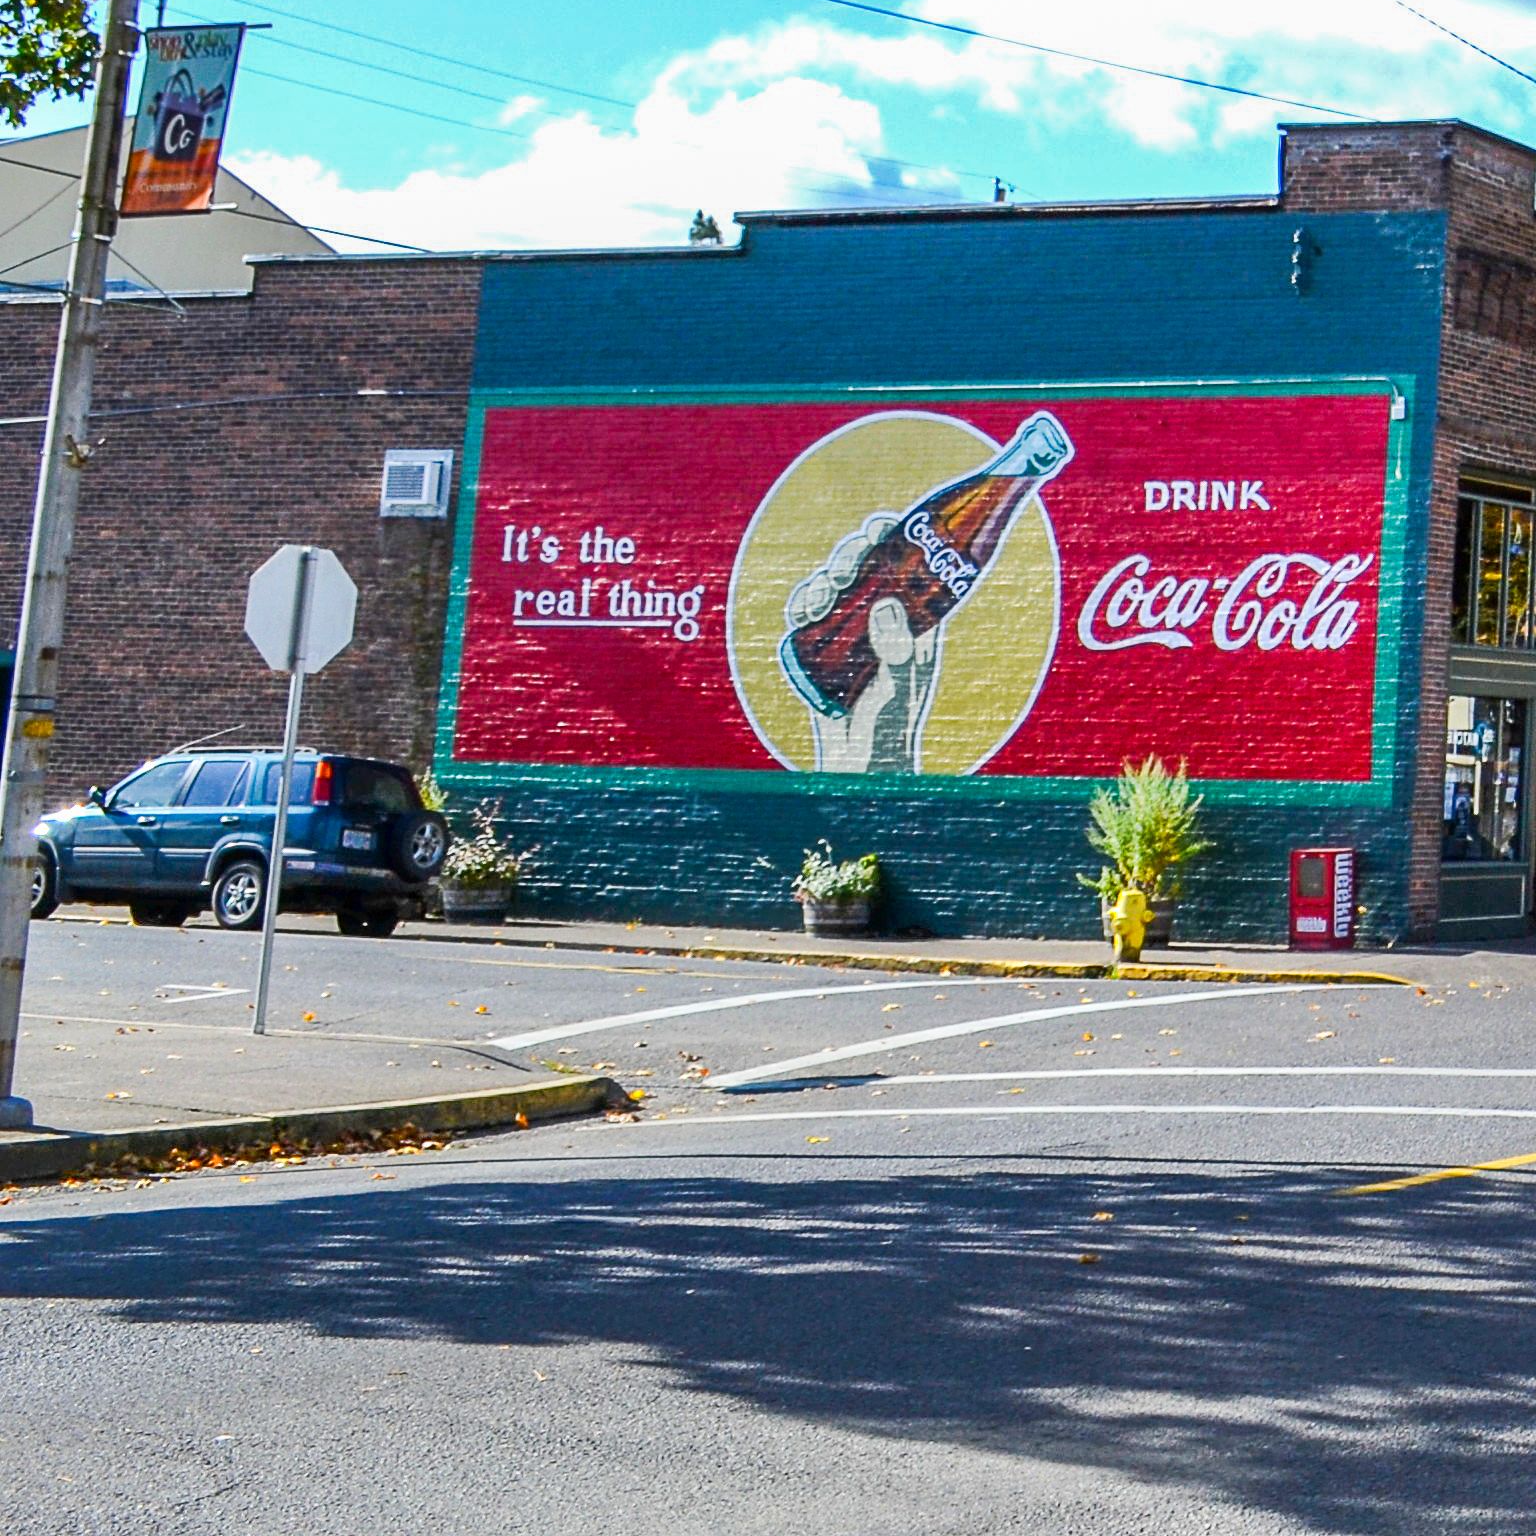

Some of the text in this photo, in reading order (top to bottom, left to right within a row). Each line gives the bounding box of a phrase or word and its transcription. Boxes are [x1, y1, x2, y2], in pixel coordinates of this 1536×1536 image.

[185, 32, 197, 60] &
[1143, 480, 1271, 511] DRINK
[501, 525, 636, 564] It's the
[904, 512, 978, 599] Coca-Cola
[513, 578, 705, 641] real thing
[1077, 553, 1374, 651] Coca-Cola
